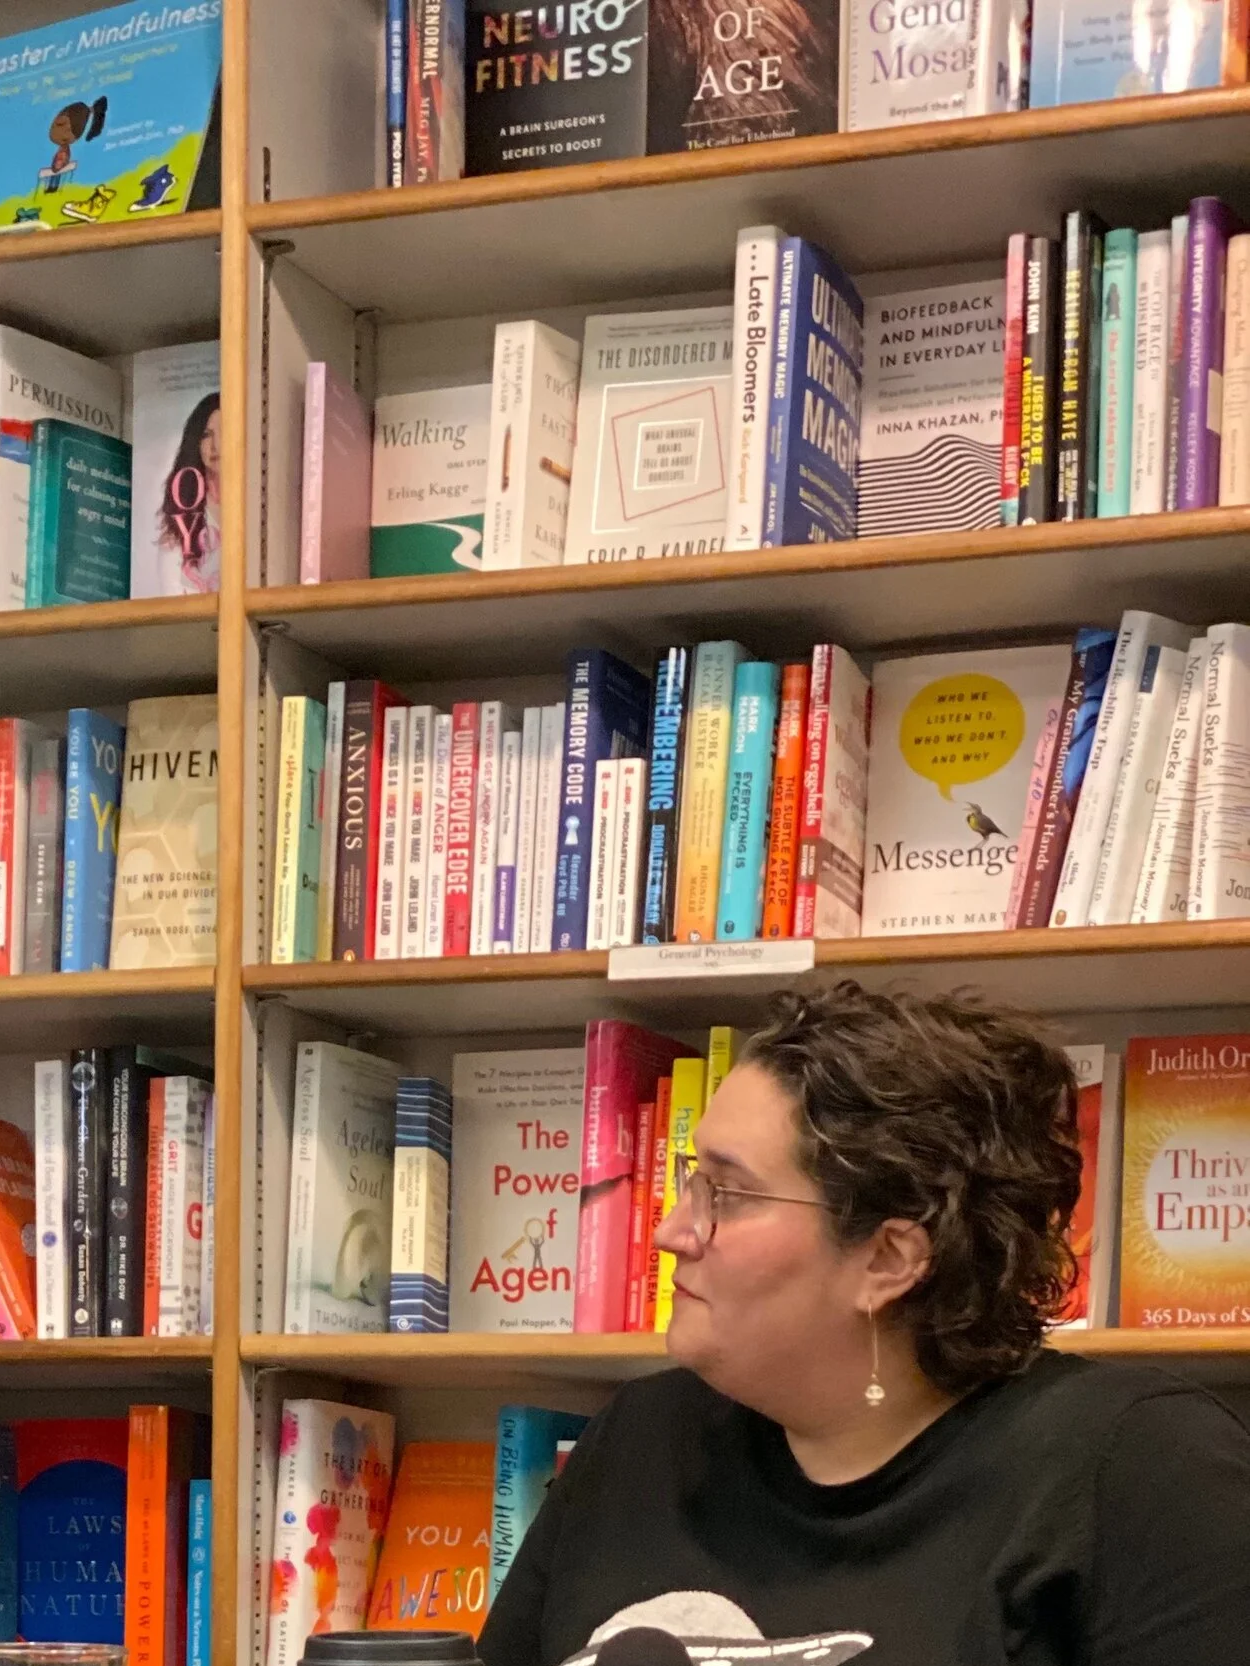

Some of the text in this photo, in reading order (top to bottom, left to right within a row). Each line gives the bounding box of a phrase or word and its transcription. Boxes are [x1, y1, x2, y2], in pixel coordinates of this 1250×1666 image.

[56, 42, 71, 58] of
[77, 1, 221, 53] Mindfulness
[483, 0, 630, 47] NEURO
[714, 8, 764, 42] OF
[475, 38, 640, 93] FITNESS
[694, 56, 783, 101] AGE
[510, 114, 606, 135] BRAIN SURGEON'S
[502, 138, 601, 161] SECRETS TO BOOST
[1026, 260, 1041, 334] JOHN KIM
[1191, 243, 1204, 314] INTEGRITY
[881, 296, 993, 323] BIOFEEDBACK
[598, 340, 718, 370] THE DISORDERED
[742, 275, 769, 423] Late Bloomers
[879, 342, 986, 369] IN EVERYDAY
[881, 328, 914, 346] AND
[1062, 348, 1079, 393] FROM
[9, 374, 115, 432] PERMISSION
[1061, 399, 1077, 441] HATE
[381, 420, 468, 450] Walking
[877, 412, 984, 435] INNA KHAZAN,
[387, 480, 470, 503] Erling Kagge
[926, 711, 972, 725] LISTEN
[1164, 655, 1202, 781] Normal Sucks
[1203, 641, 1226, 767] Normal Sucks
[565, 660, 590, 806] THE MEMORY CODE
[707, 717, 721, 761] WORK
[1089, 732, 1109, 771] Trap
[931, 751, 990, 765] AND WHY
[1035, 680, 1086, 871] My Grandmother's Hands
[68, 785, 79, 820] YOU
[344, 726, 367, 850] ANXIOUS
[805, 743, 822, 826] on eggshells
[432, 802, 445, 854] ANGER
[447, 730, 472, 896] UNDERCOVER EDGE
[735, 771, 753, 869] EVERYTHING IS
[778, 776, 795, 907] THE SUBTLE ART OF
[169, 871, 213, 883] SCIENCE
[881, 914, 956, 929] STEPHEN
[659, 942, 765, 960] General Psychology
[1147, 1046, 1215, 1075] Judith
[517, 1122, 569, 1150] The
[167, 1139, 178, 1174] GRIT
[653, 1137, 666, 1200] NO SELF
[347, 1162, 385, 1200] Soul
[1143, 1308, 1239, 1329] 365 Days of
[494, 1418, 519, 1569] ON BEING HUMAN
[49, 1514, 122, 1535] LAWS
[406, 1526, 461, 1547] YOU
[137, 1571, 150, 1664] POWER
